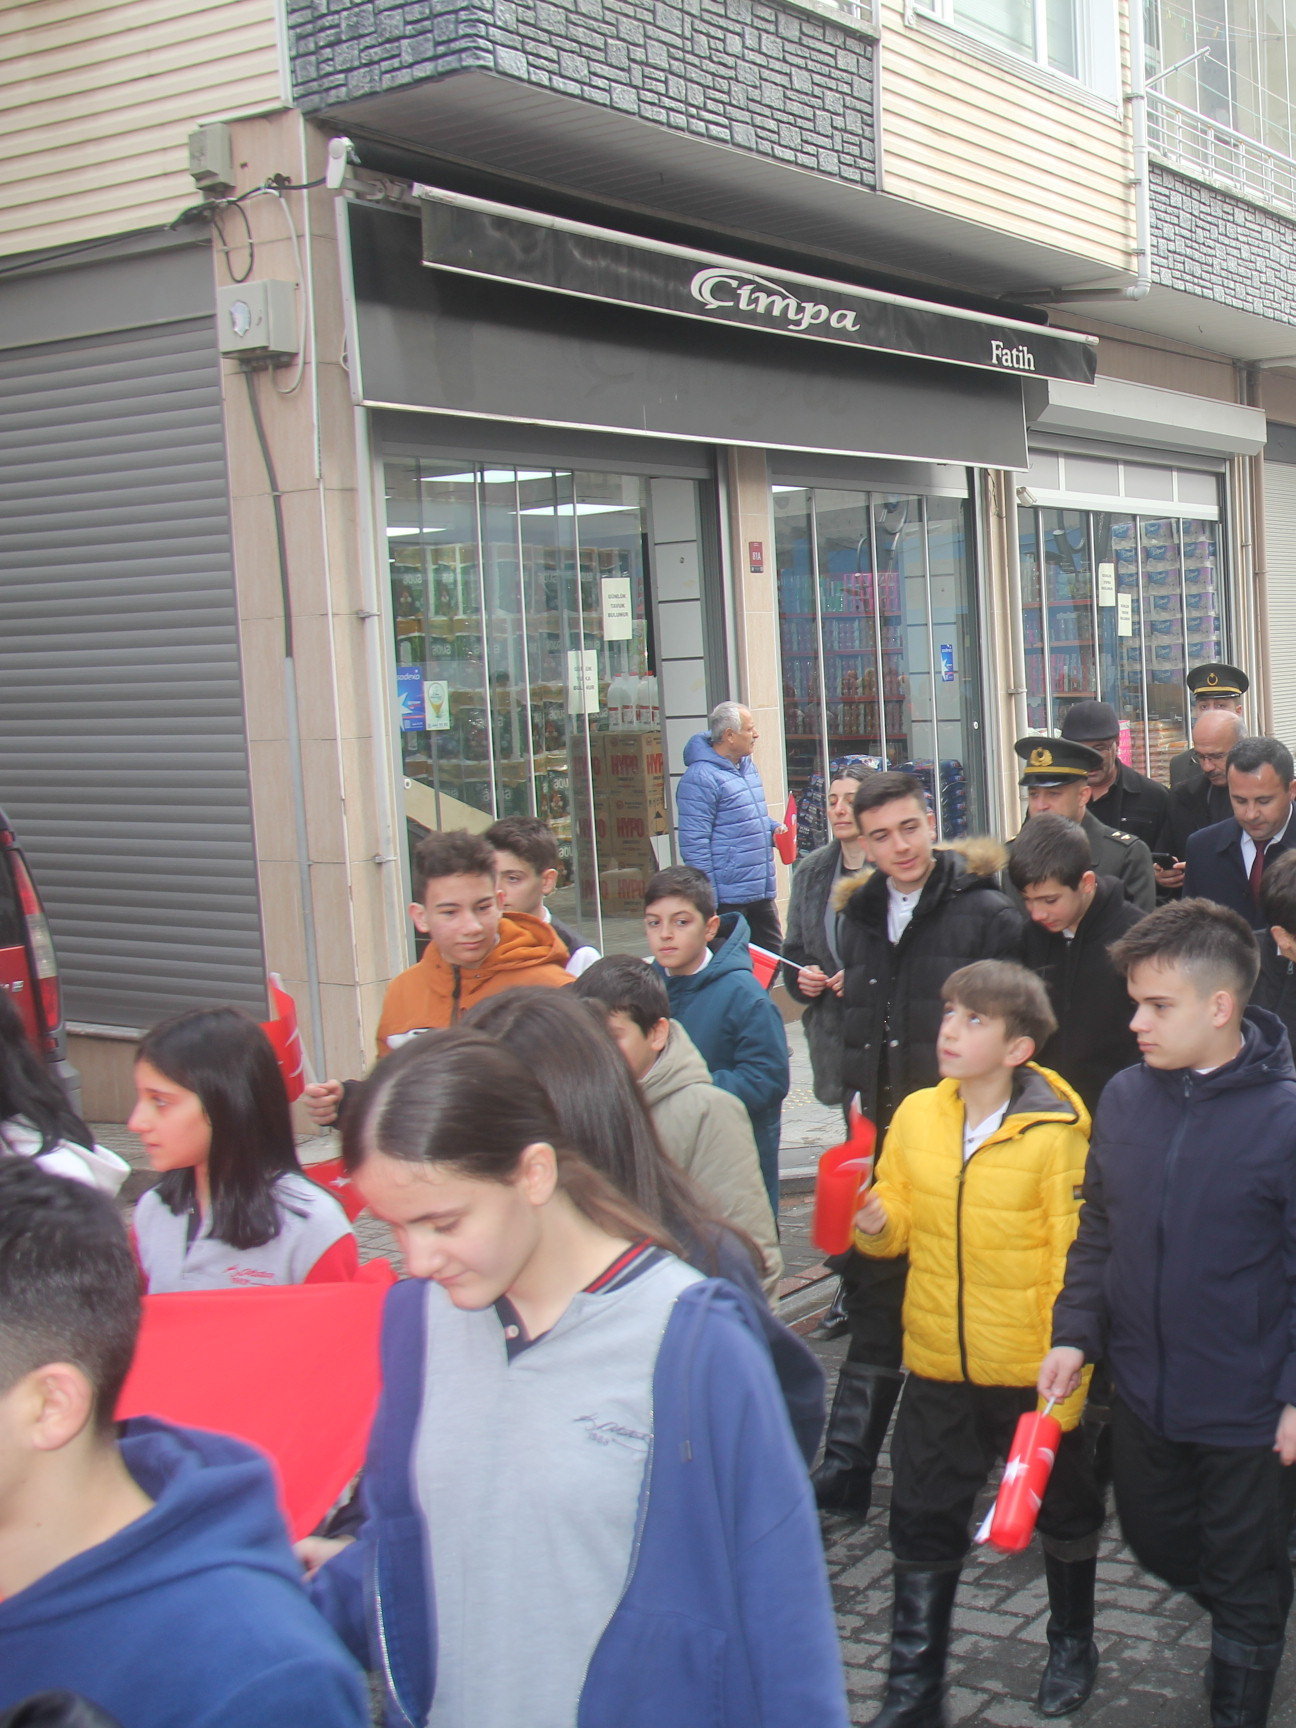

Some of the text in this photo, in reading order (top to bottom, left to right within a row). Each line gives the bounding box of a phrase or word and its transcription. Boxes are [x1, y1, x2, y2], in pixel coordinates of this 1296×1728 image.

[692, 269, 861, 331] Çimpa
[991, 340, 1035, 370] Fatih
[610, 754, 639, 776] HYPO
[646, 753, 664, 775] HYP
